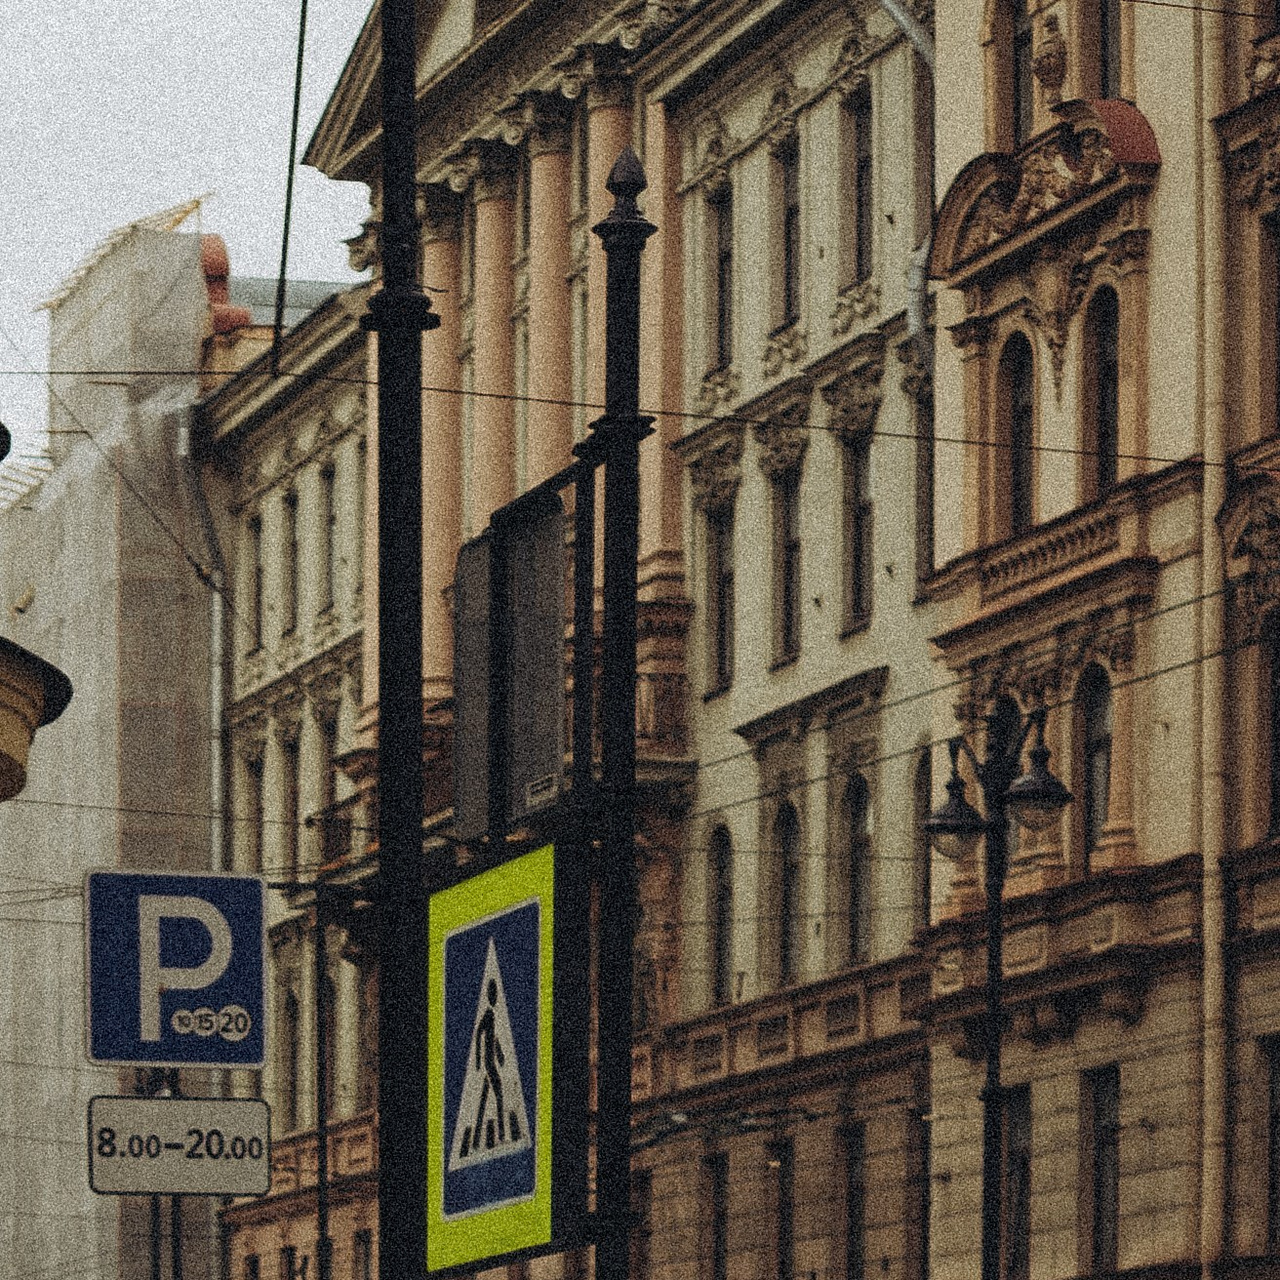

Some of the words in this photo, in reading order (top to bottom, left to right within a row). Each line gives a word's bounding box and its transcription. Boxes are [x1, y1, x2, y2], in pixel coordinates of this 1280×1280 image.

[139, 895, 232, 1041] P
[197, 1013, 214, 1031] 15
[221, 1012, 249, 1033] 20
